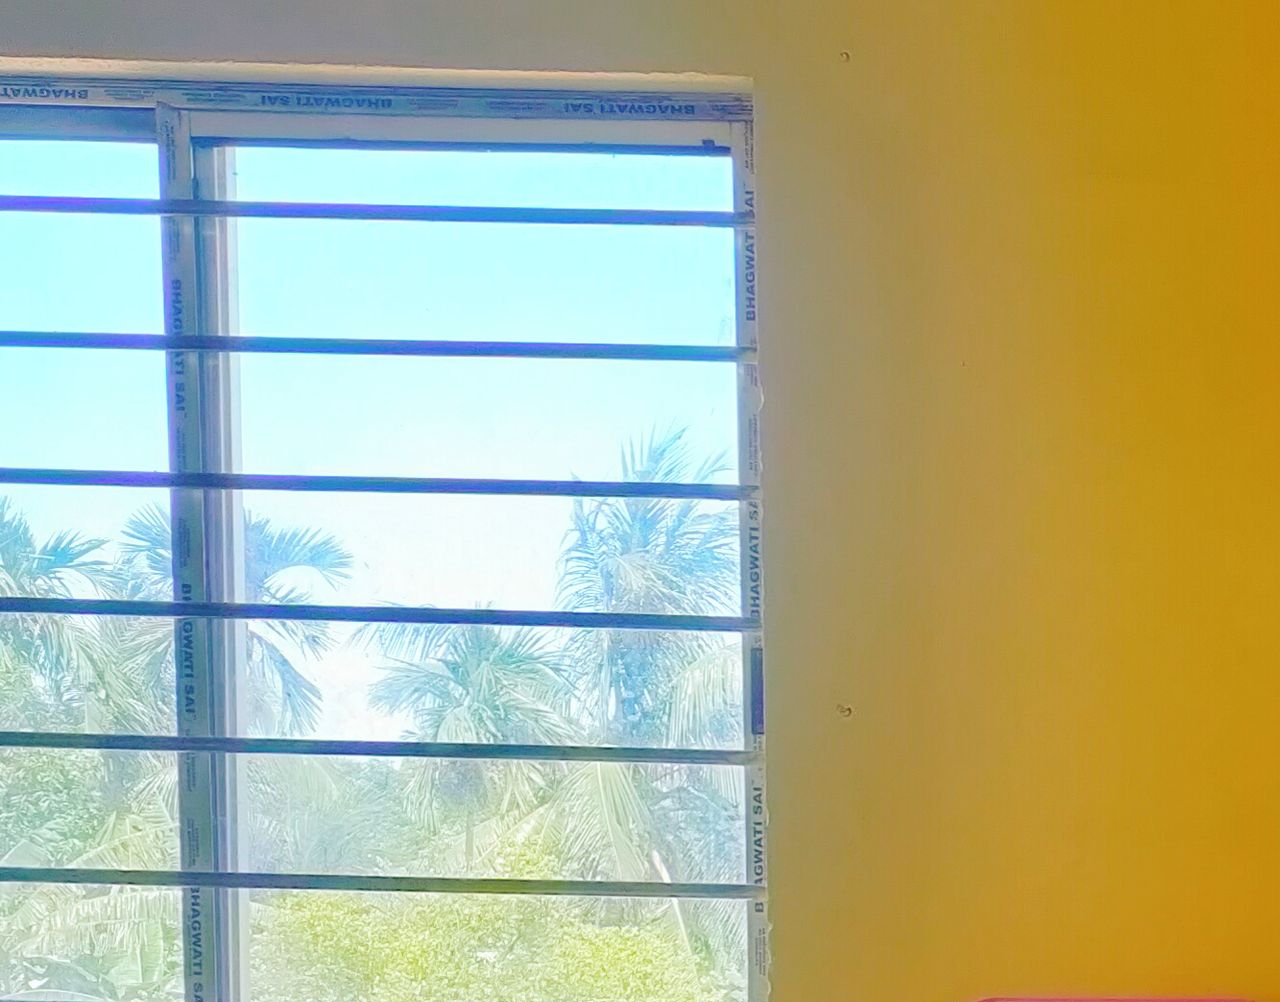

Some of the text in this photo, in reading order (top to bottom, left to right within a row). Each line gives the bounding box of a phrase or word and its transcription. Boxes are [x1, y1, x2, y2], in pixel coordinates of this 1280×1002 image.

[0, 87, 89, 100] BHAGWAT
[261, 95, 290, 106] SAI
[296, 96, 393, 109] BHAGWATI
[564, 102, 695, 115] BHAGWATI SAI
[744, 232, 756, 321] BHAGWAT
[171, 279, 185, 411] BHAGATI SAI
[749, 501, 760, 521] SA
[181, 583, 195, 713] BGWATI SAI
[752, 786, 764, 913] BAGWATI SAI
